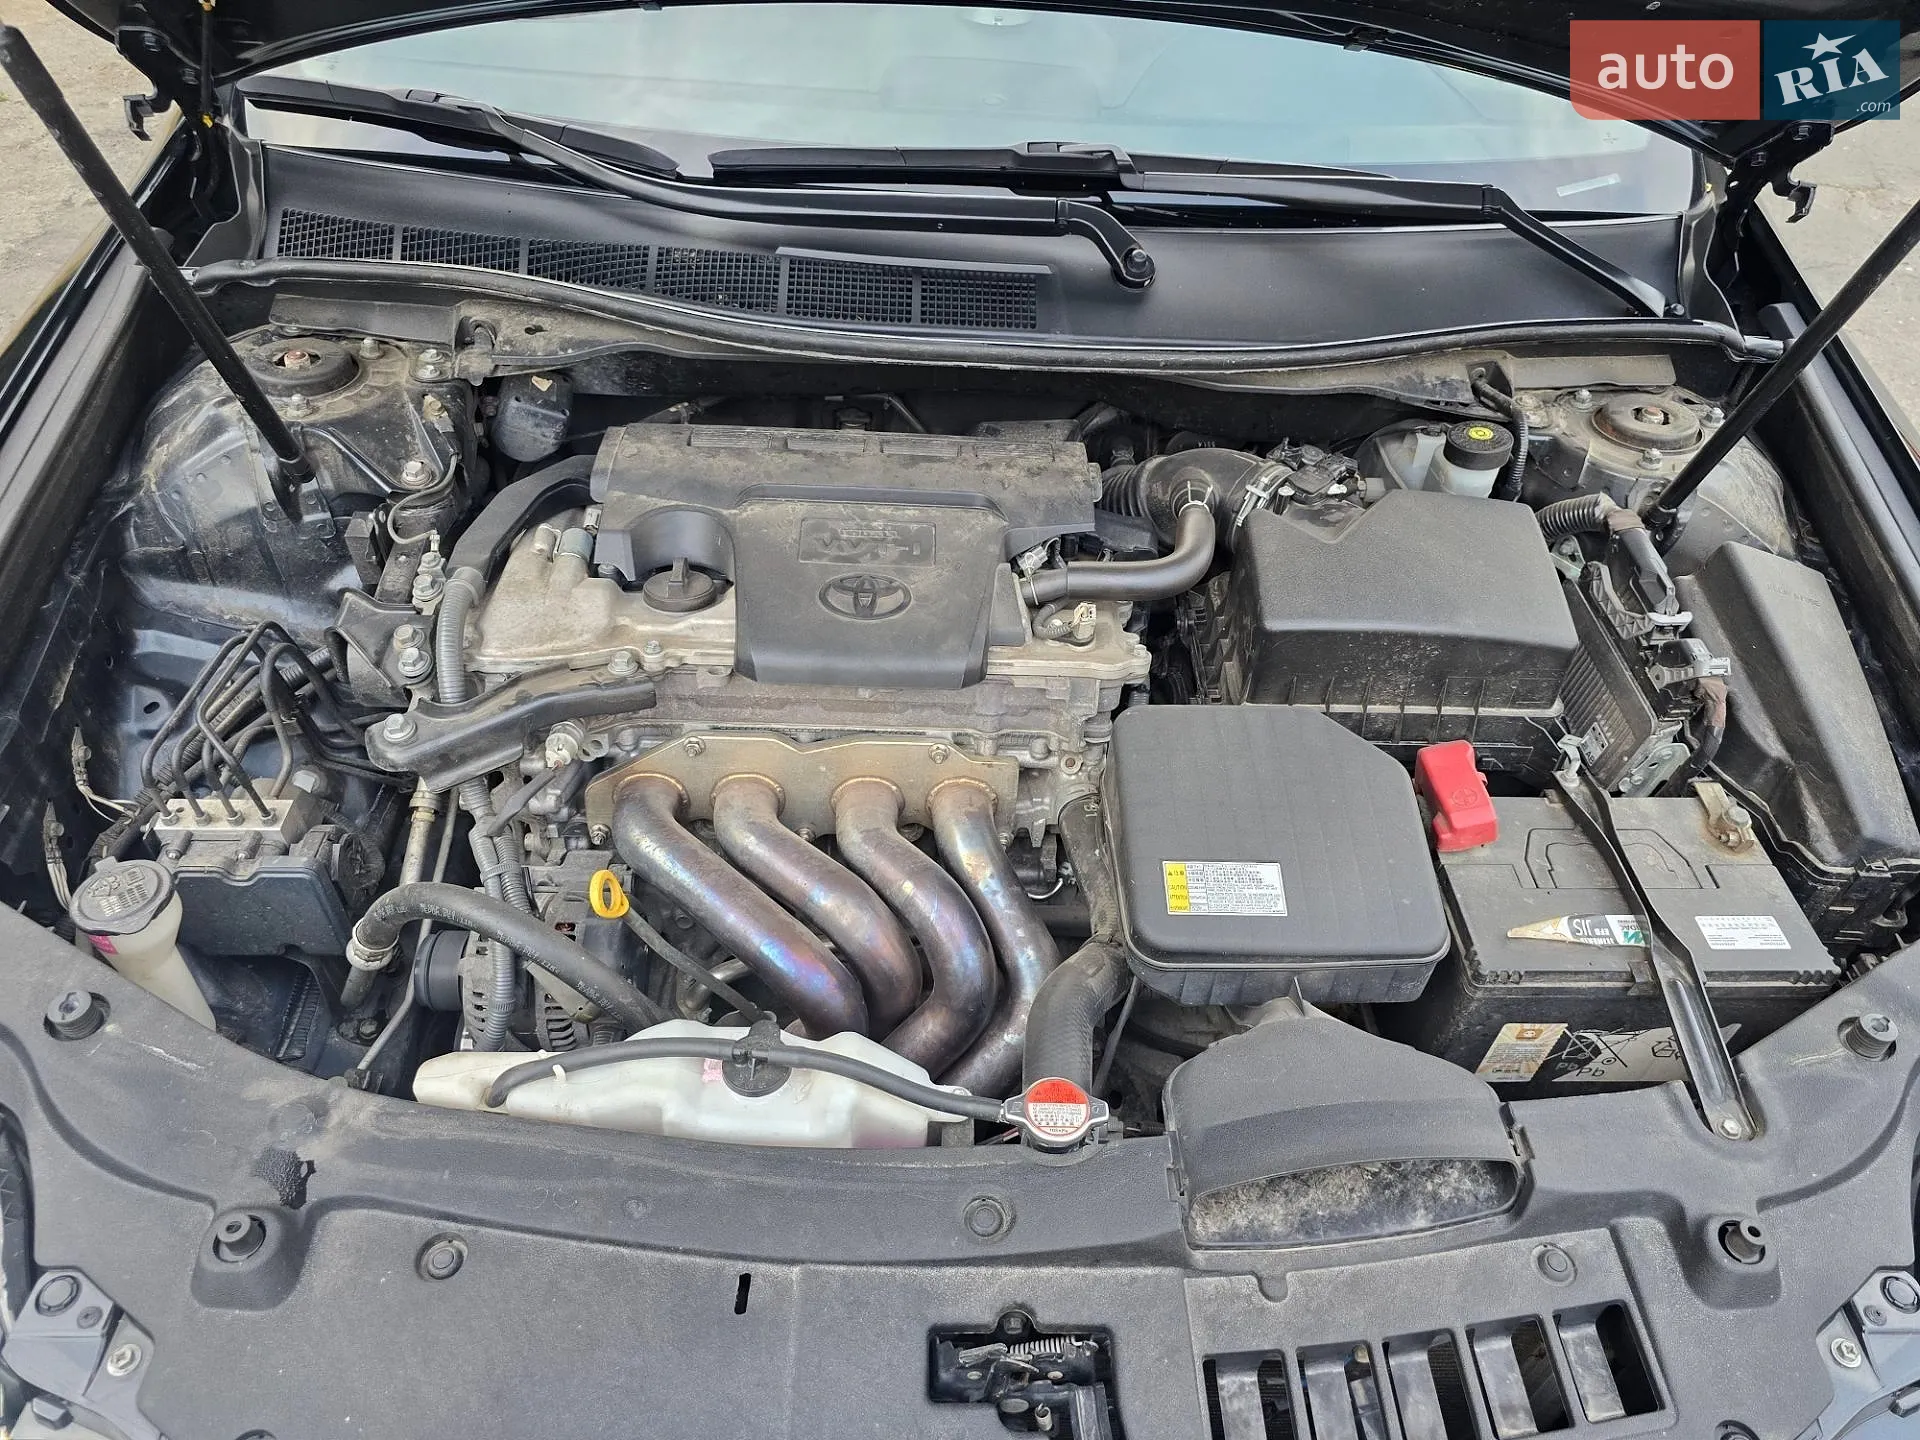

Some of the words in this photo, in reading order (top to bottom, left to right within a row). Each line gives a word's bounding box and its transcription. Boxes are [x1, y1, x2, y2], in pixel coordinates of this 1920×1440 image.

[1573, 918, 1592, 936] JIS
[1555, 1061, 1579, 1071] Pb
[1576, 1068, 1605, 1077] Pb
